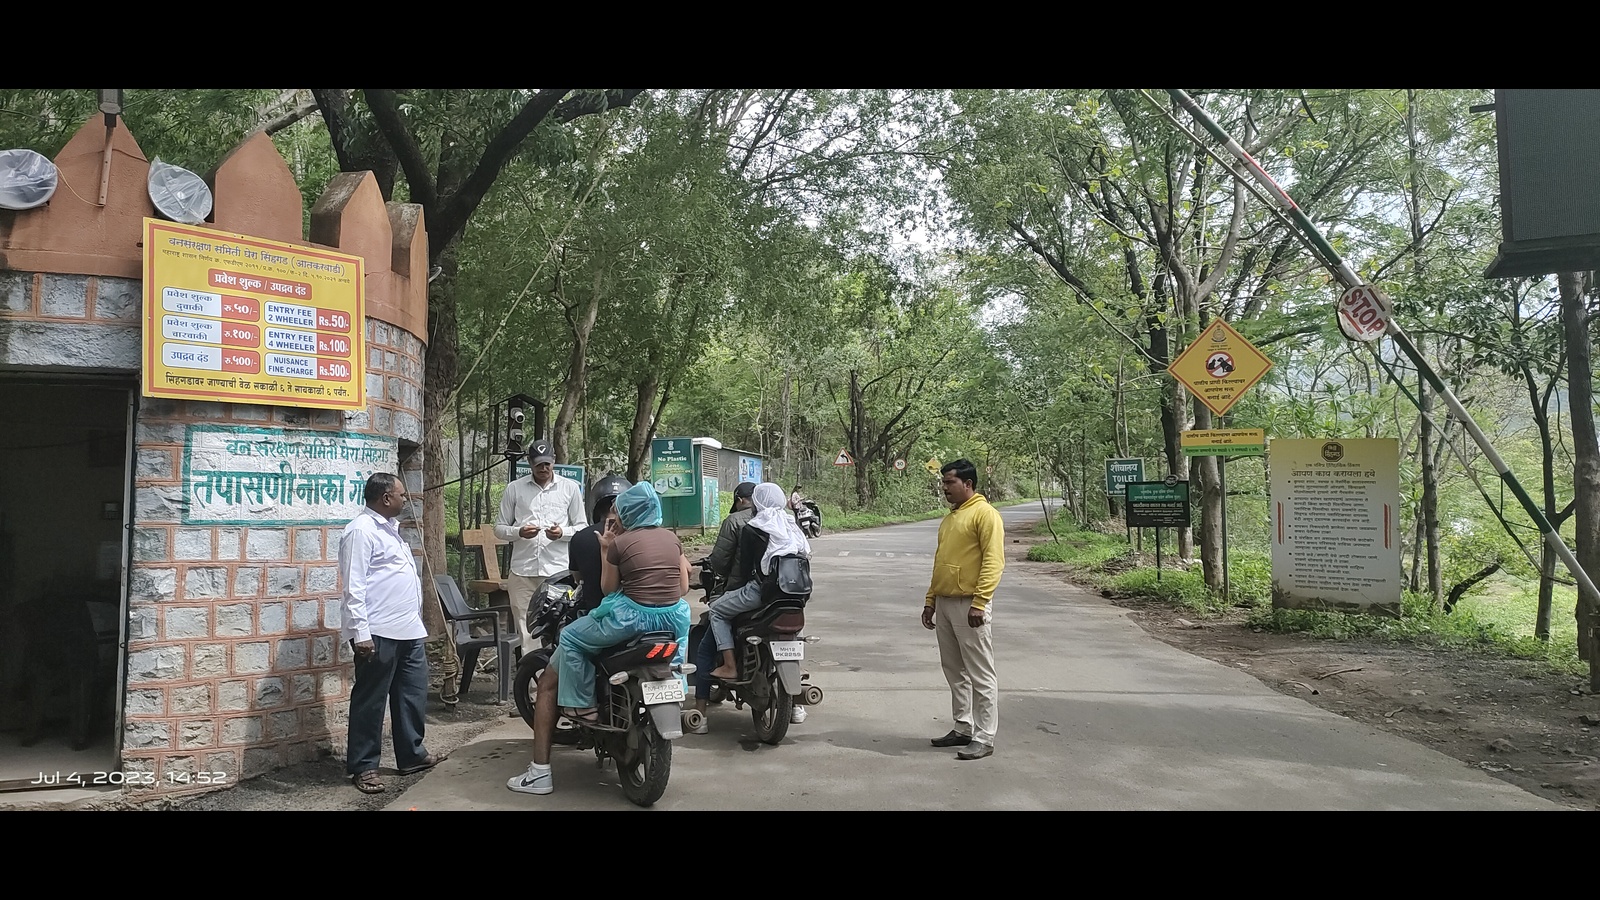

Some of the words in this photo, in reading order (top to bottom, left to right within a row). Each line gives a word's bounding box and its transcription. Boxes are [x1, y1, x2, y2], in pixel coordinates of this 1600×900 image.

[168, 237, 211, 252] वनसंरक्षण
[214, 244, 241, 257] समिती
[244, 248, 258, 260] घेरा
[260, 250, 288, 265] सिंहगड
[214, 272, 237, 286] प्रवेश
[239, 276, 262, 291] शुल्क
[270, 281, 293, 294] उपद्रव
[295, 283, 307, 296] दंड
[166, 289, 188, 300] प्रवेश
[191, 292, 213, 303] शुल्क
[176, 302, 203, 313] दुचाकी
[268, 305, 295, 315] ENTRY
[297, 308, 312, 317] FEE
[1344, 288, 1385, 333] STOP
[166, 318, 188, 328] प्रवेश
[191, 321, 213, 331] शुल्क
[277, 315, 314, 327] WHEELER
[268, 331, 296, 341] ENTRY
[298, 334, 314, 343] FEE
[277, 341, 315, 351] WHEELER
[170, 350, 194, 361] उपद्रव
[196, 351, 209, 363] दंड
[273, 356, 308, 366] NUISANCE
[268, 365, 284, 374] FINE
[286, 367, 314, 376] CHARGE
[165, 371, 204, 386] सिंहगडावर
[206, 375, 237, 388] जाण्याची
[239, 377, 251, 390] वेळ
[253, 379, 278, 392] सकाळी
[225, 439, 251, 455] वन
[255, 436, 300, 458] संरक्षण
[302, 438, 338, 461] समिती
[340, 439, 359, 462] घेरा
[1110, 461, 1138, 473] शौचालय
[192, 461, 296, 509] तपासणी
[296, 474, 346, 506] नाका
[645, 690, 683, 702] 7483
